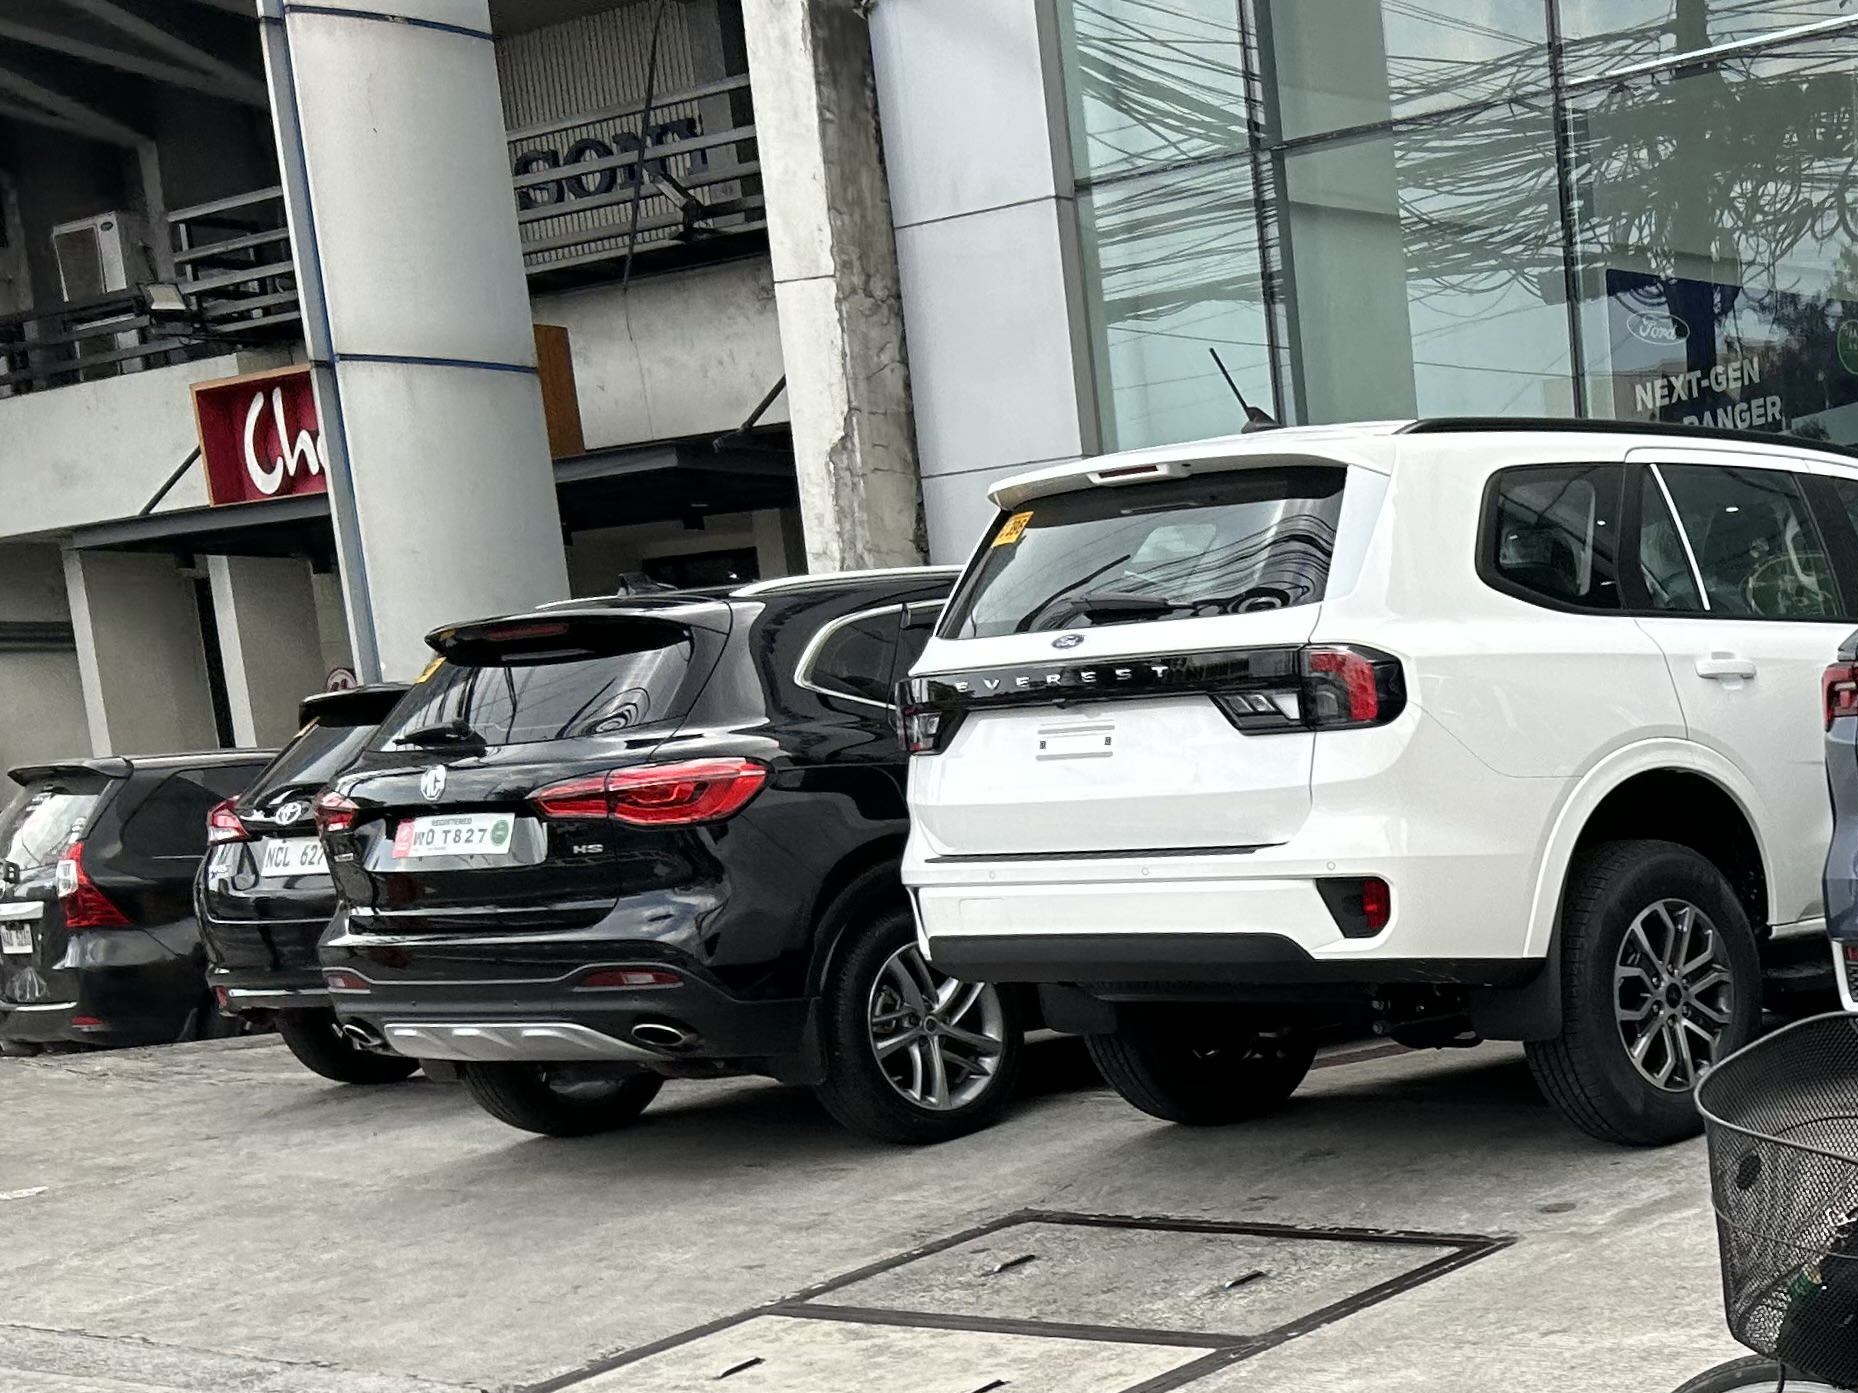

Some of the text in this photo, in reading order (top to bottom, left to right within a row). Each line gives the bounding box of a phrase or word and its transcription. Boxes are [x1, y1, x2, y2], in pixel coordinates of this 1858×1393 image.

[1638, 315, 1678, 341] Ford
[1634, 357, 1760, 412] NEXT-GEN
[955, 665, 1169, 693] EVEREST
[442, 828, 489, 845] T827
[265, 846, 291, 867] NCL
[572, 844, 604, 854] HS
